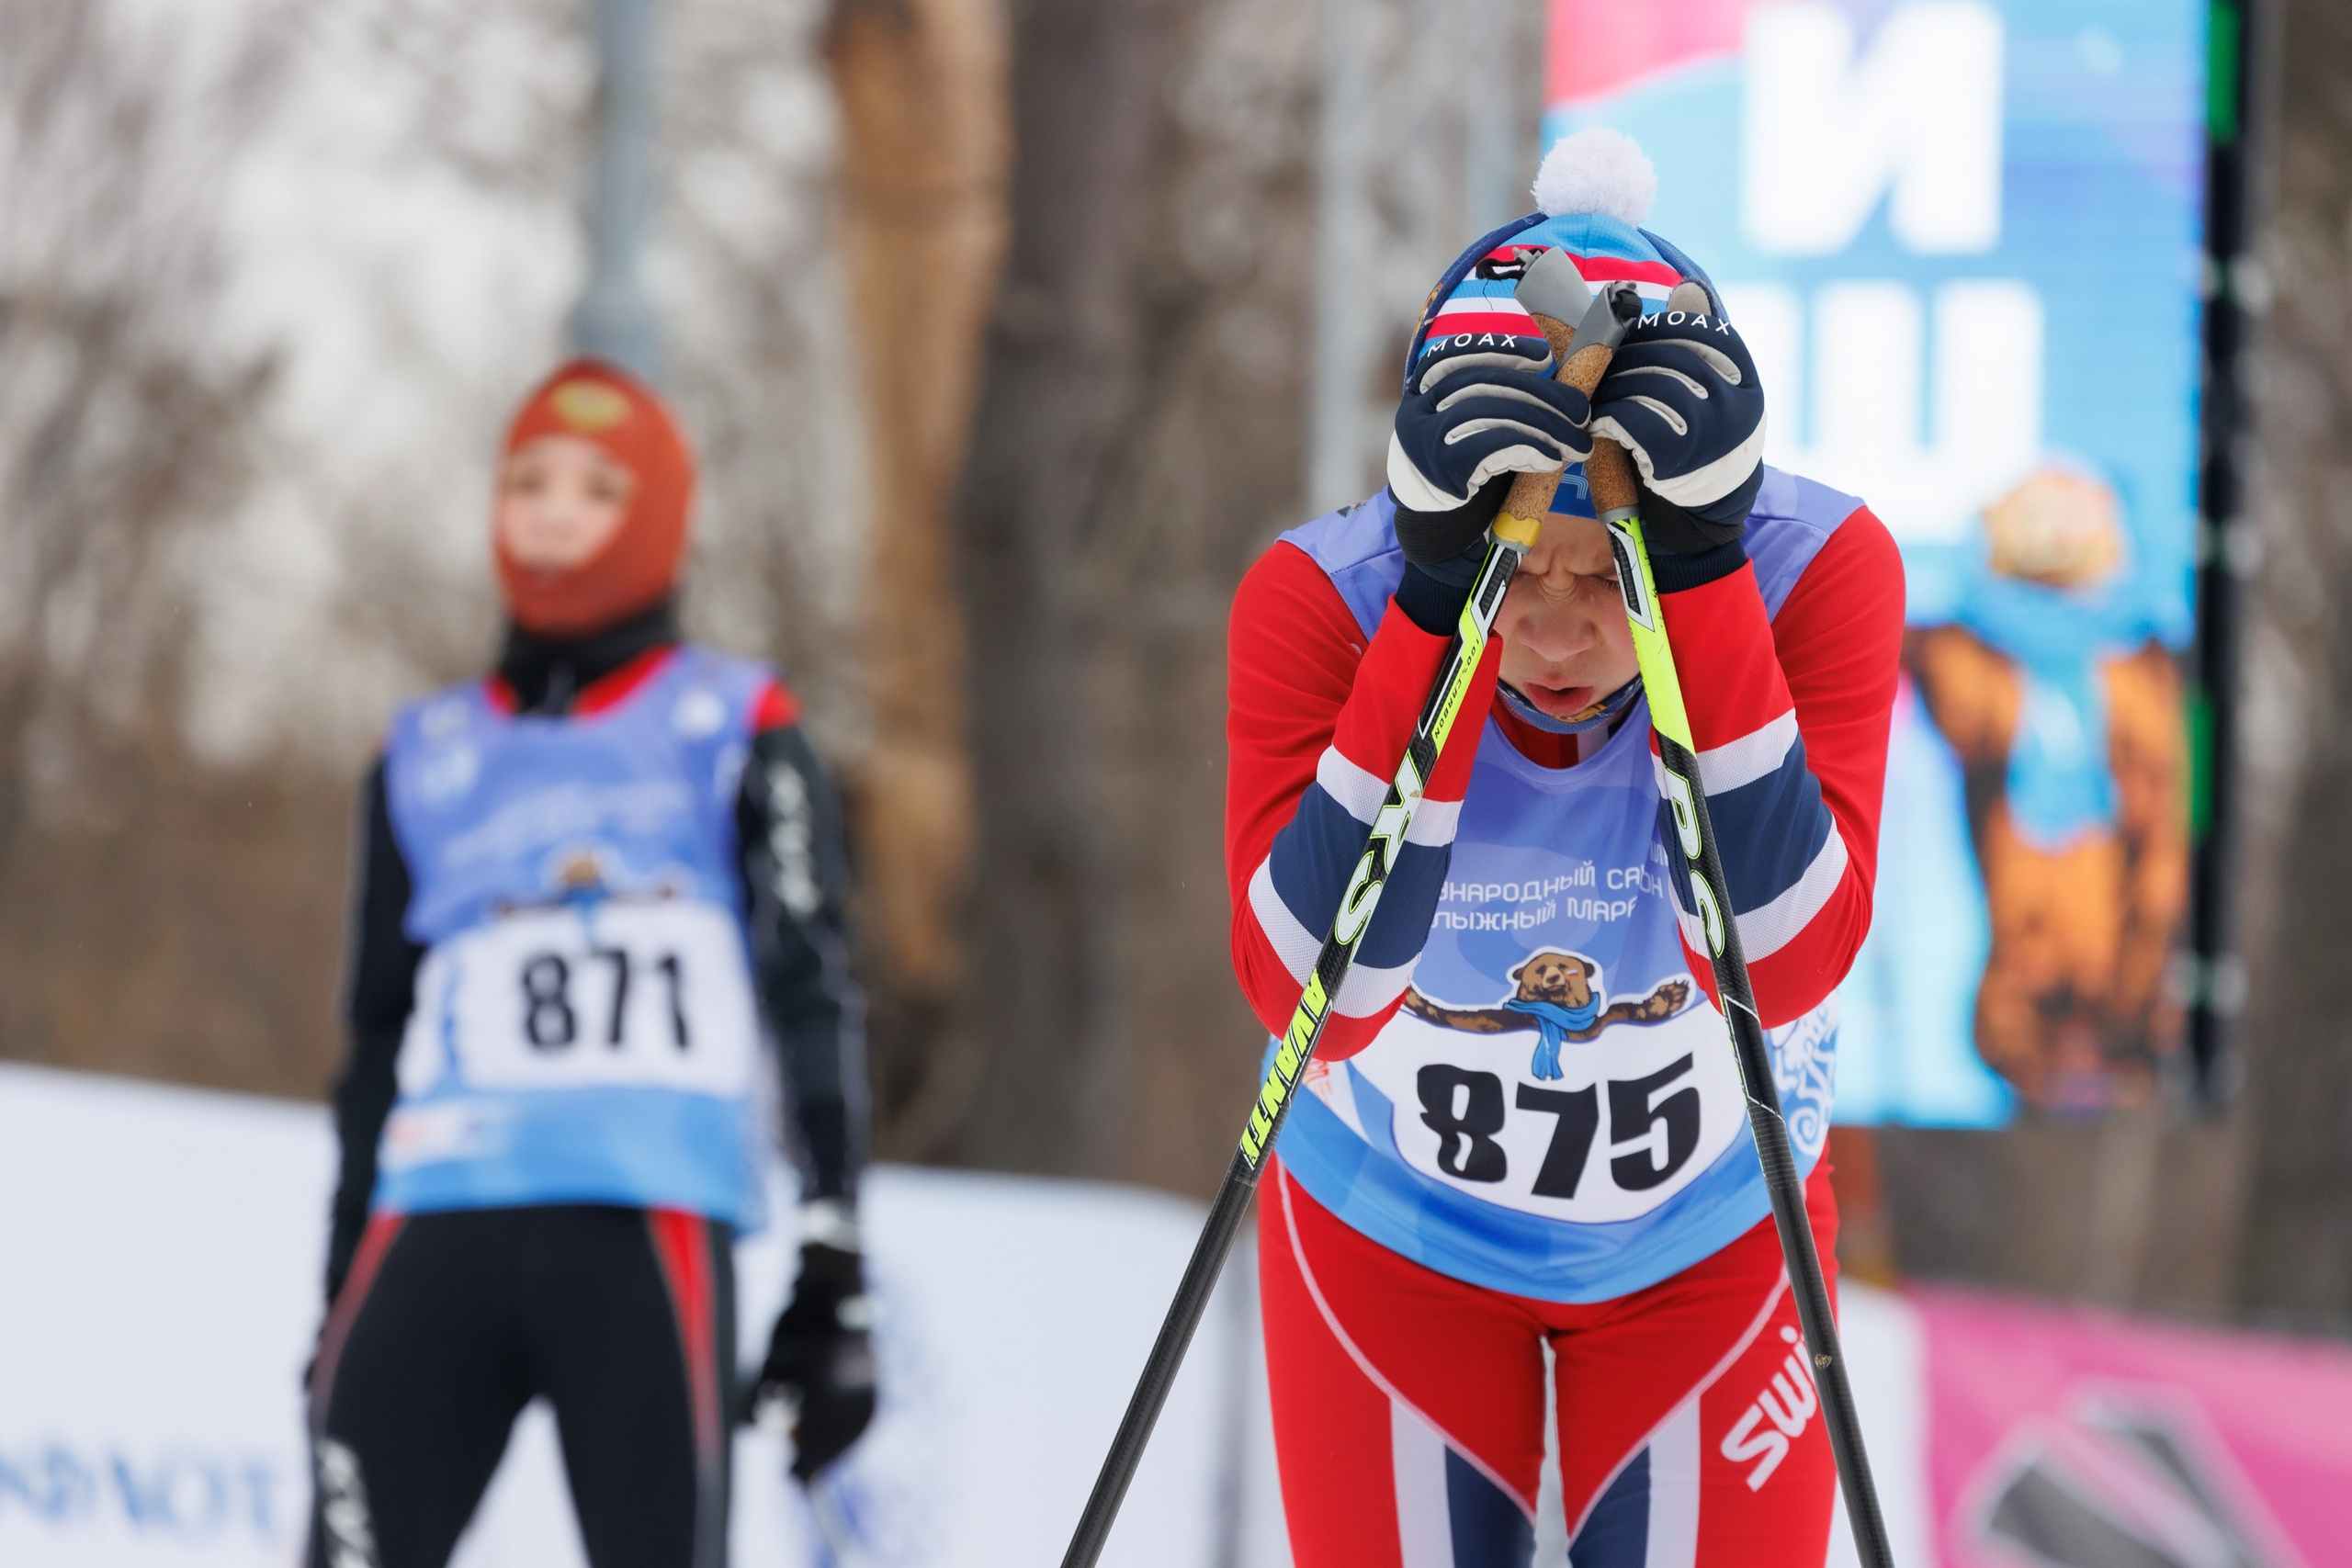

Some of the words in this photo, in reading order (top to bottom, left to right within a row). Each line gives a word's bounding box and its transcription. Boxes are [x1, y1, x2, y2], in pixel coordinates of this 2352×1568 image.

[1427, 333, 1518, 357] MOAX
[1637, 310, 1730, 335] MOAX
[1434, 678, 1463, 739] CARBON
[1335, 749, 1424, 967] RS
[1430, 900, 1557, 931] ЛЫЖНЫЙ
[521, 946, 692, 1052] 871
[1240, 967, 1329, 1167] AVANTI
[1417, 1052, 1701, 1200] 875
